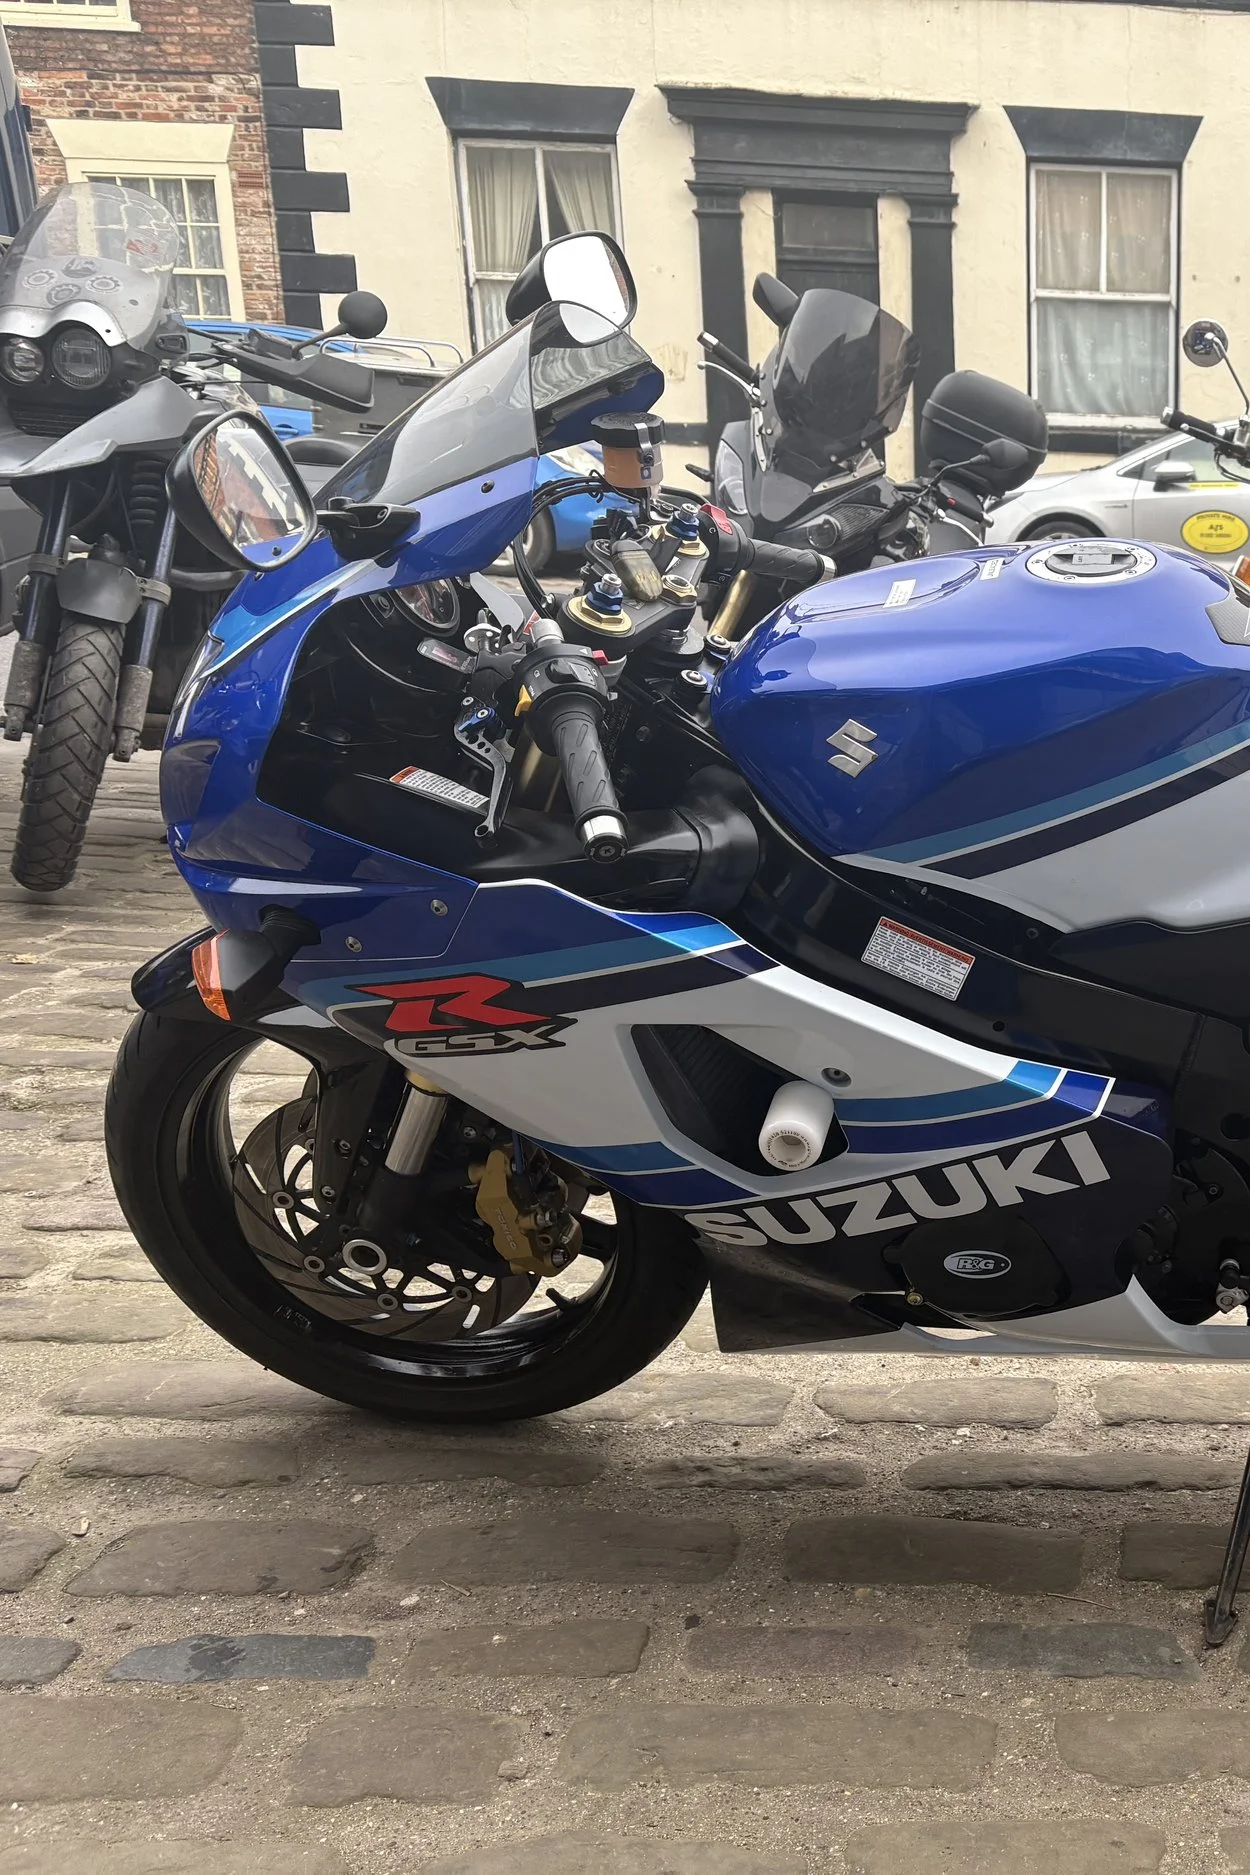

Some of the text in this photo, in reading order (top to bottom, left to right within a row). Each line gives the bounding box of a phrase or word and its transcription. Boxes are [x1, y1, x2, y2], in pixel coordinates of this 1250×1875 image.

[350, 974, 554, 1032] R
[396, 1024, 557, 1054] GSX
[684, 1130, 1112, 1247] SUZUKI
[958, 1257, 996, 1271] R&G
